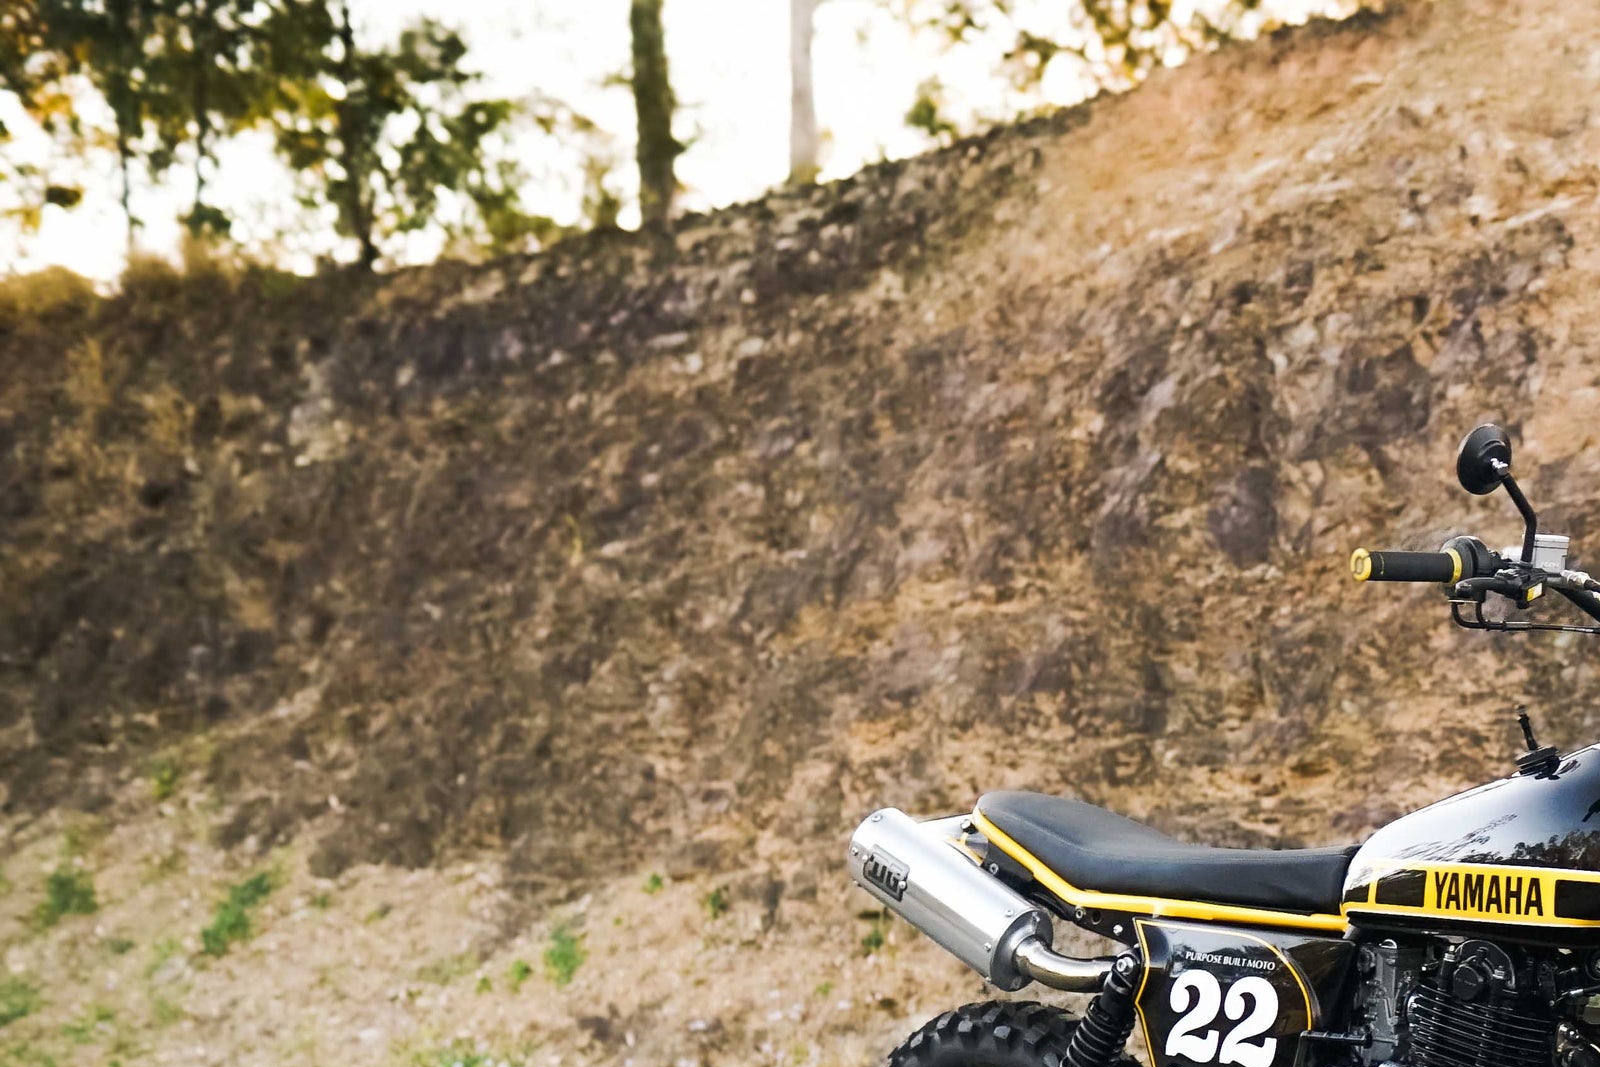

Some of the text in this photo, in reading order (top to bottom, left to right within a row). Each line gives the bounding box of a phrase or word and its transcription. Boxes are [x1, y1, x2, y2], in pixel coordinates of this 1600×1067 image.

[1434, 871, 1544, 917] YAMAHA
[1185, 951, 1276, 971] PURPOSE BUILT MOTO
